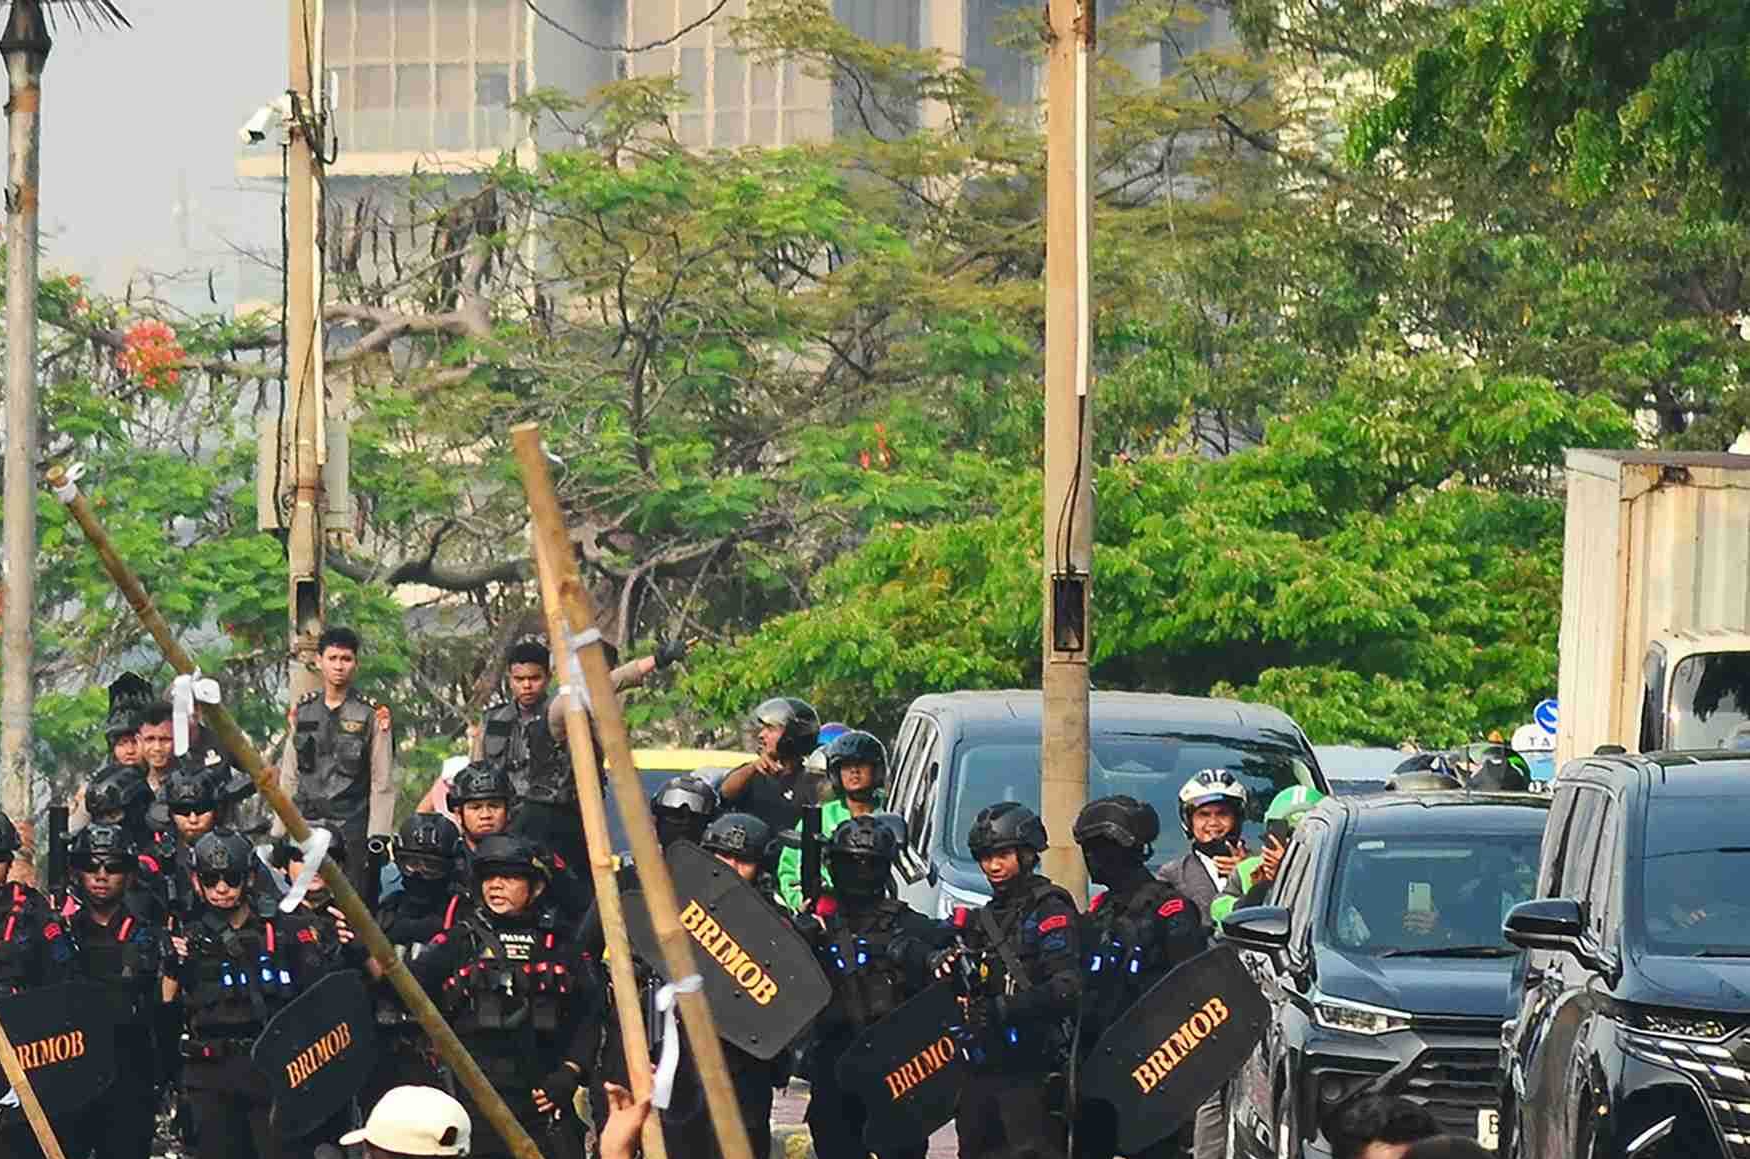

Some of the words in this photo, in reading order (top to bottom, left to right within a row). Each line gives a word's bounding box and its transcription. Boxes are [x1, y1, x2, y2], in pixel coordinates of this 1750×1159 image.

[1530, 737, 1550, 747] TA
[680, 900, 778, 1005] BRIMOB
[16, 1030, 84, 1070] RIMOB
[286, 1022, 351, 1088] BRIMOB
[884, 1036, 955, 1100] BRIMO
[1132, 998, 1229, 1093] BRIMOB
